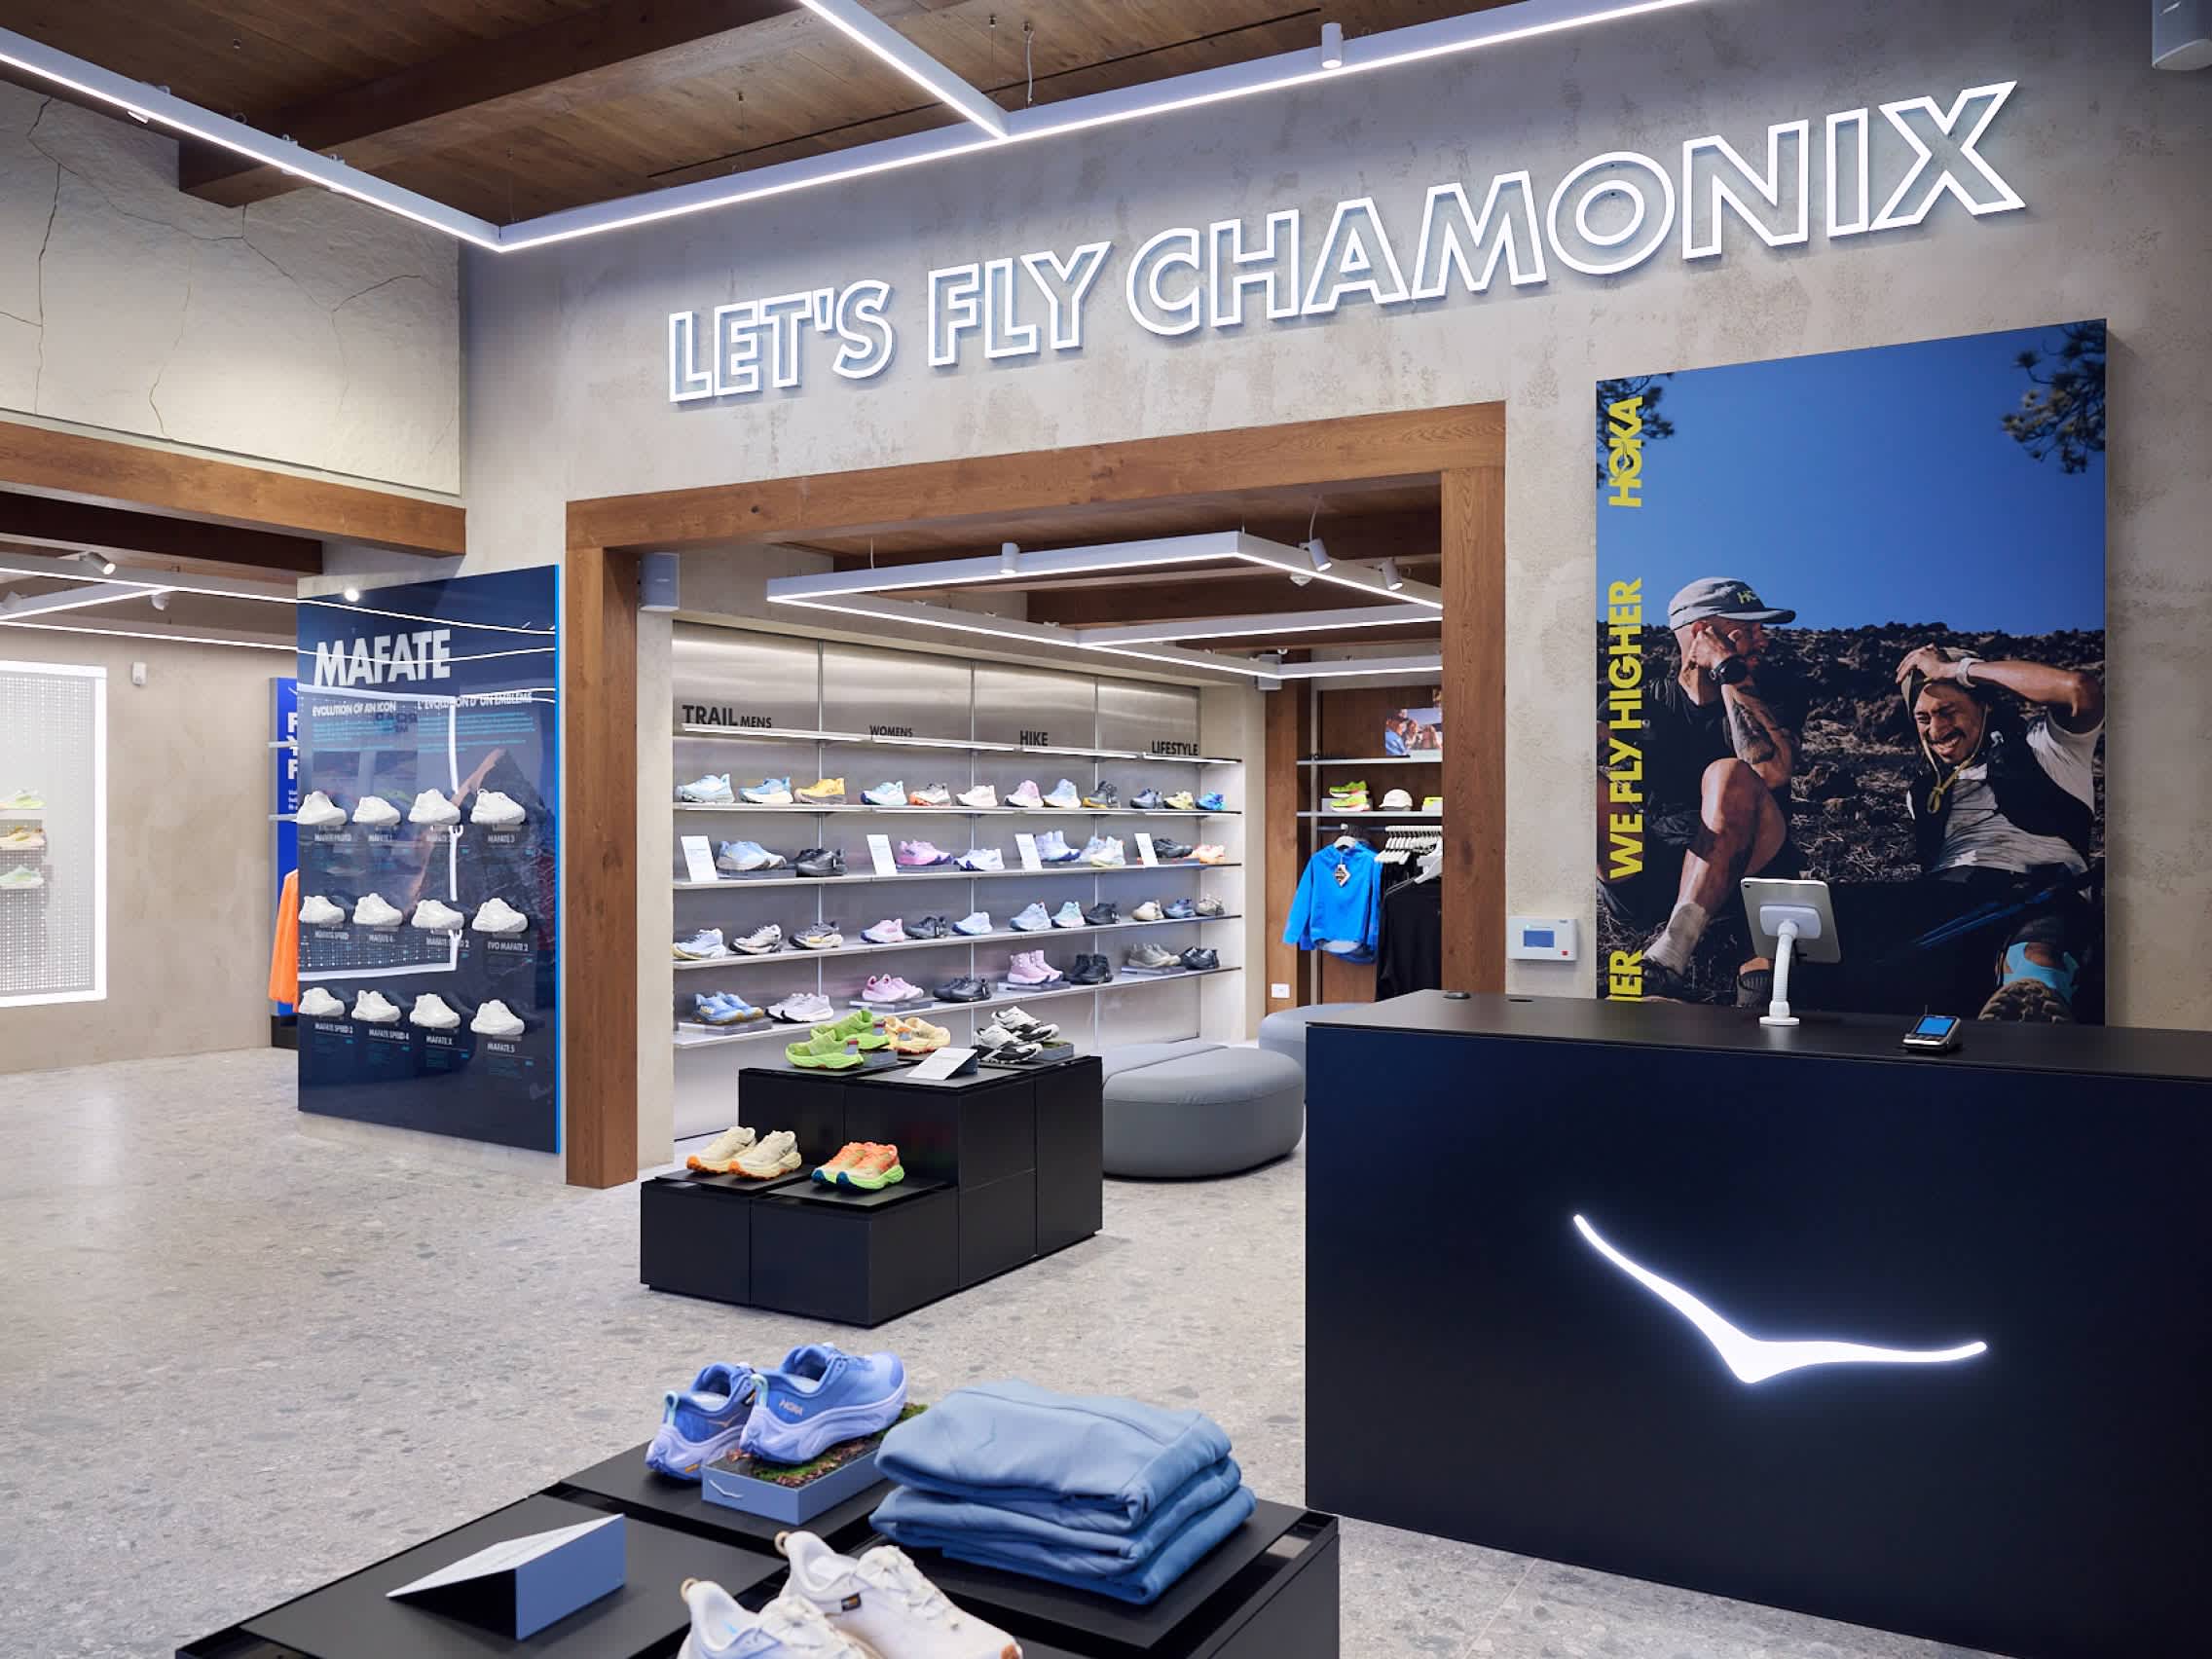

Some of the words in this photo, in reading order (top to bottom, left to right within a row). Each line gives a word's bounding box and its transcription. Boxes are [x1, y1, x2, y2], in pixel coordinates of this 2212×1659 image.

[669, 279, 894, 402] LET'S
[928, 241, 1113, 366] FLY
[1126, 81, 2025, 336] CHAMONIX
[1608, 395, 1643, 506] HOKA
[313, 629, 452, 686] MAFATE
[1608, 576, 1643, 729] HIGHER
[312, 704, 352, 718] EVOLUTION
[353, 703, 364, 715] OF
[376, 700, 396, 714] ICON
[682, 704, 738, 726] TRAIL
[740, 716, 772, 728] MENS
[869, 724, 913, 738] WOMENS
[1019, 730, 1049, 747] HIKE
[1151, 740, 1198, 756] LIFESTYLE
[1609, 737, 1643, 802] FLY
[1609, 814, 1643, 879] WE
[1609, 949, 1643, 1003] ER
